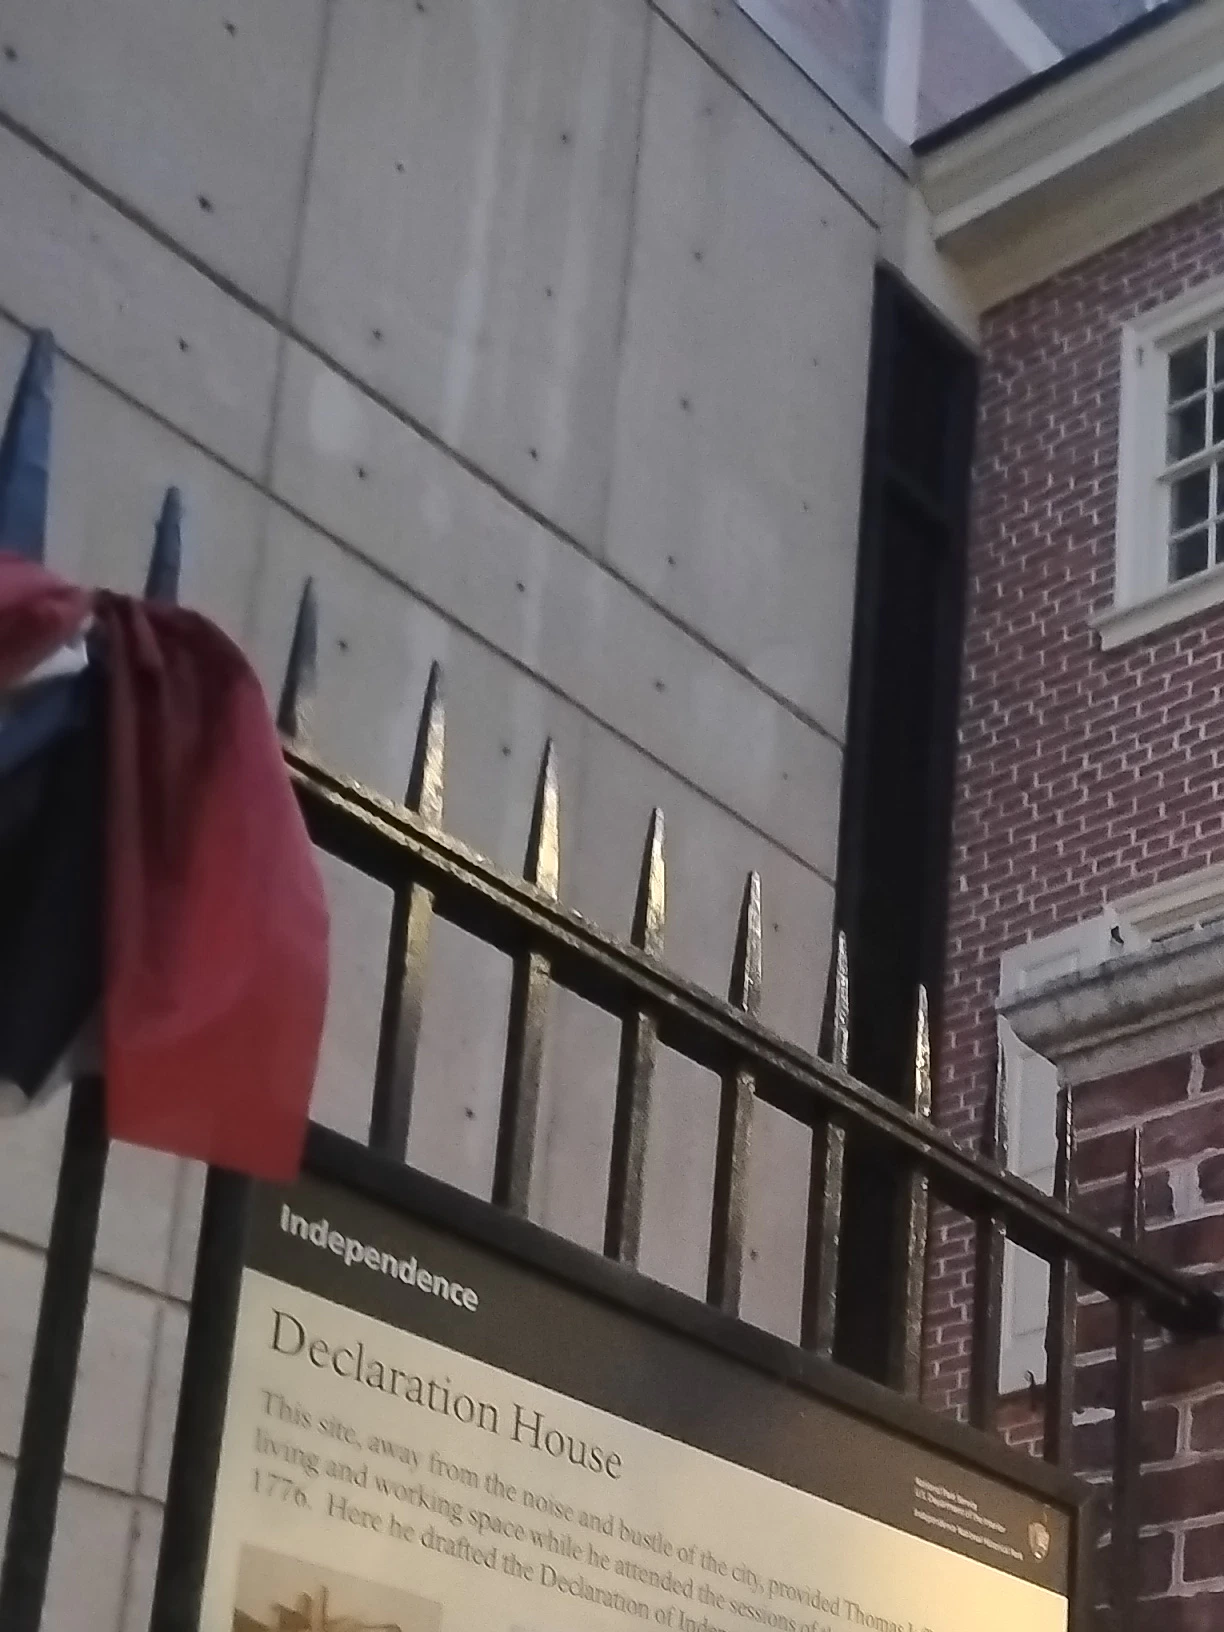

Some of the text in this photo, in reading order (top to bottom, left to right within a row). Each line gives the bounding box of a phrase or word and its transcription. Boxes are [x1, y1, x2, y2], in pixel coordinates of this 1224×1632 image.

[279, 1202, 479, 1313] Independence
[270, 1306, 623, 1480] Declaration House
[254, 1426, 320, 1478] living
[325, 1459, 369, 1489] and
[375, 1474, 464, 1528] working
[467, 1507, 526, 1542] space
[530, 1528, 584, 1561] while
[587, 1542, 612, 1571] he
[614, 1557, 694, 1600] attended
[698, 1583, 726, 1610] the
[261, 1387, 313, 1429] This
[317, 1416, 363, 1451] site,
[367, 1436, 419, 1474] away
[429, 1450, 479, 1489] from
[484, 1471, 518, 1502] the
[522, 1489, 574, 1522] noise
[578, 1510, 614, 1537] and
[618, 1518, 673, 1558] bustle
[677, 1543, 698, 1566] of
[700, 1549, 728, 1577] the
[731, 1563, 765, 1595] city,
[768, 1578, 840, 1618] provided
[327, 1492, 383, 1533] Here
[388, 1512, 416, 1543] he
[420, 1524, 498, 1571] drafted
[501, 1552, 535, 1583] the
[539, 1562, 650, 1621] Declaration
[654, 1604, 677, 1628] of
